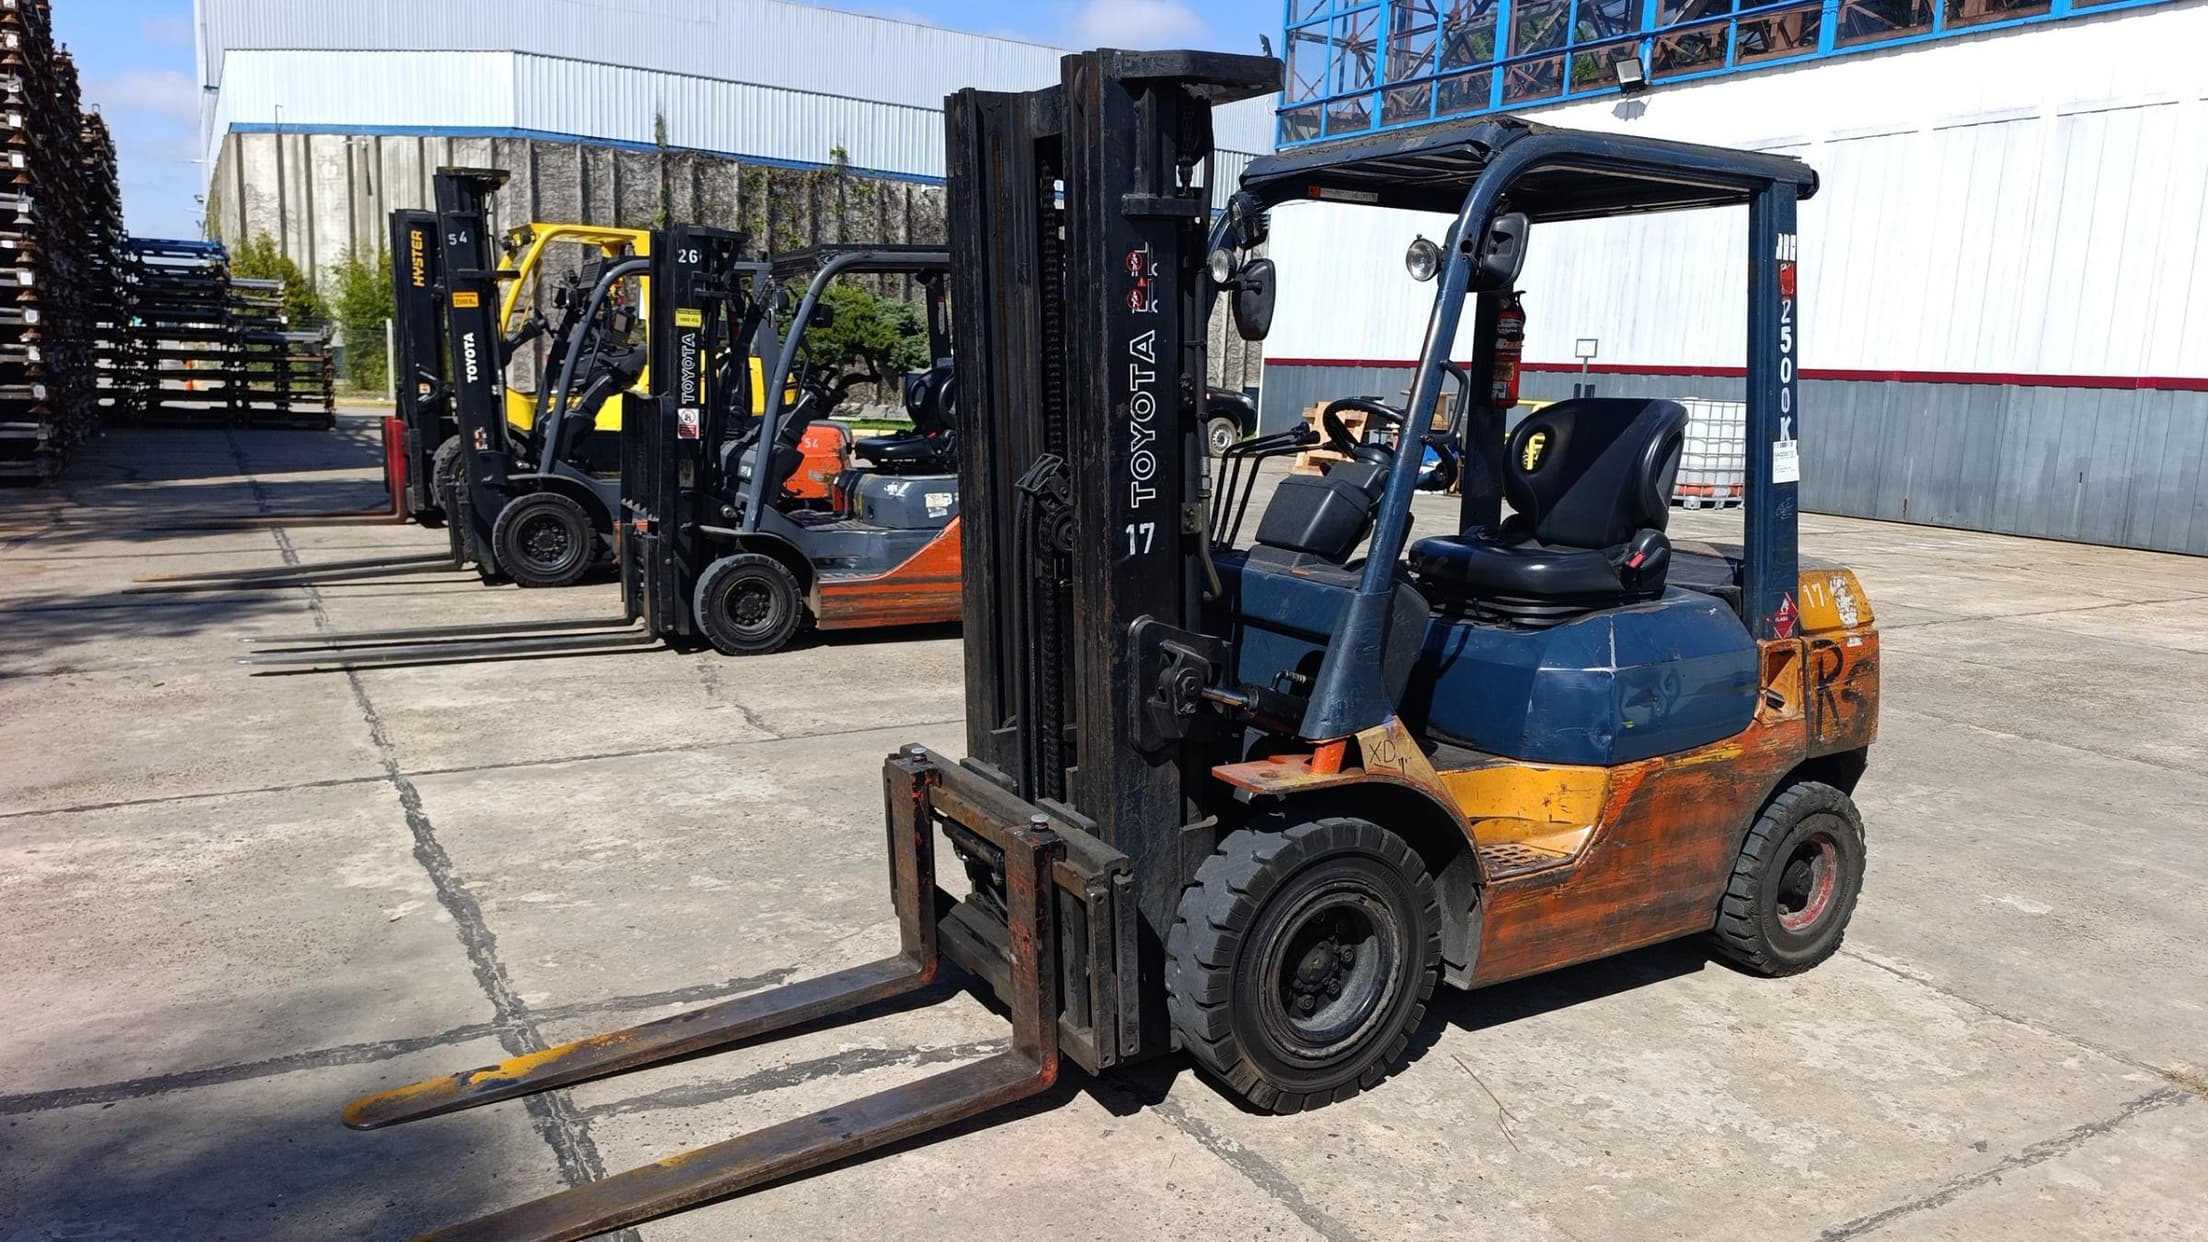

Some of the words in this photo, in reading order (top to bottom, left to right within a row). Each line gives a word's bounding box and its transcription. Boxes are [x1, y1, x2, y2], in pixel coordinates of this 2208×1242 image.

[448, 231, 468, 246] 54
[410, 229, 425, 287] HYSTER
[678, 249, 698, 264] 26
[463, 331, 479, 384] TOYOTA
[681, 332, 696, 405] TOYOTA
[1129, 329, 1157, 509] TOYOTA
[804, 437, 820, 449] 54
[1125, 522, 1156, 556] 17
[1802, 582, 1825, 609] 17
